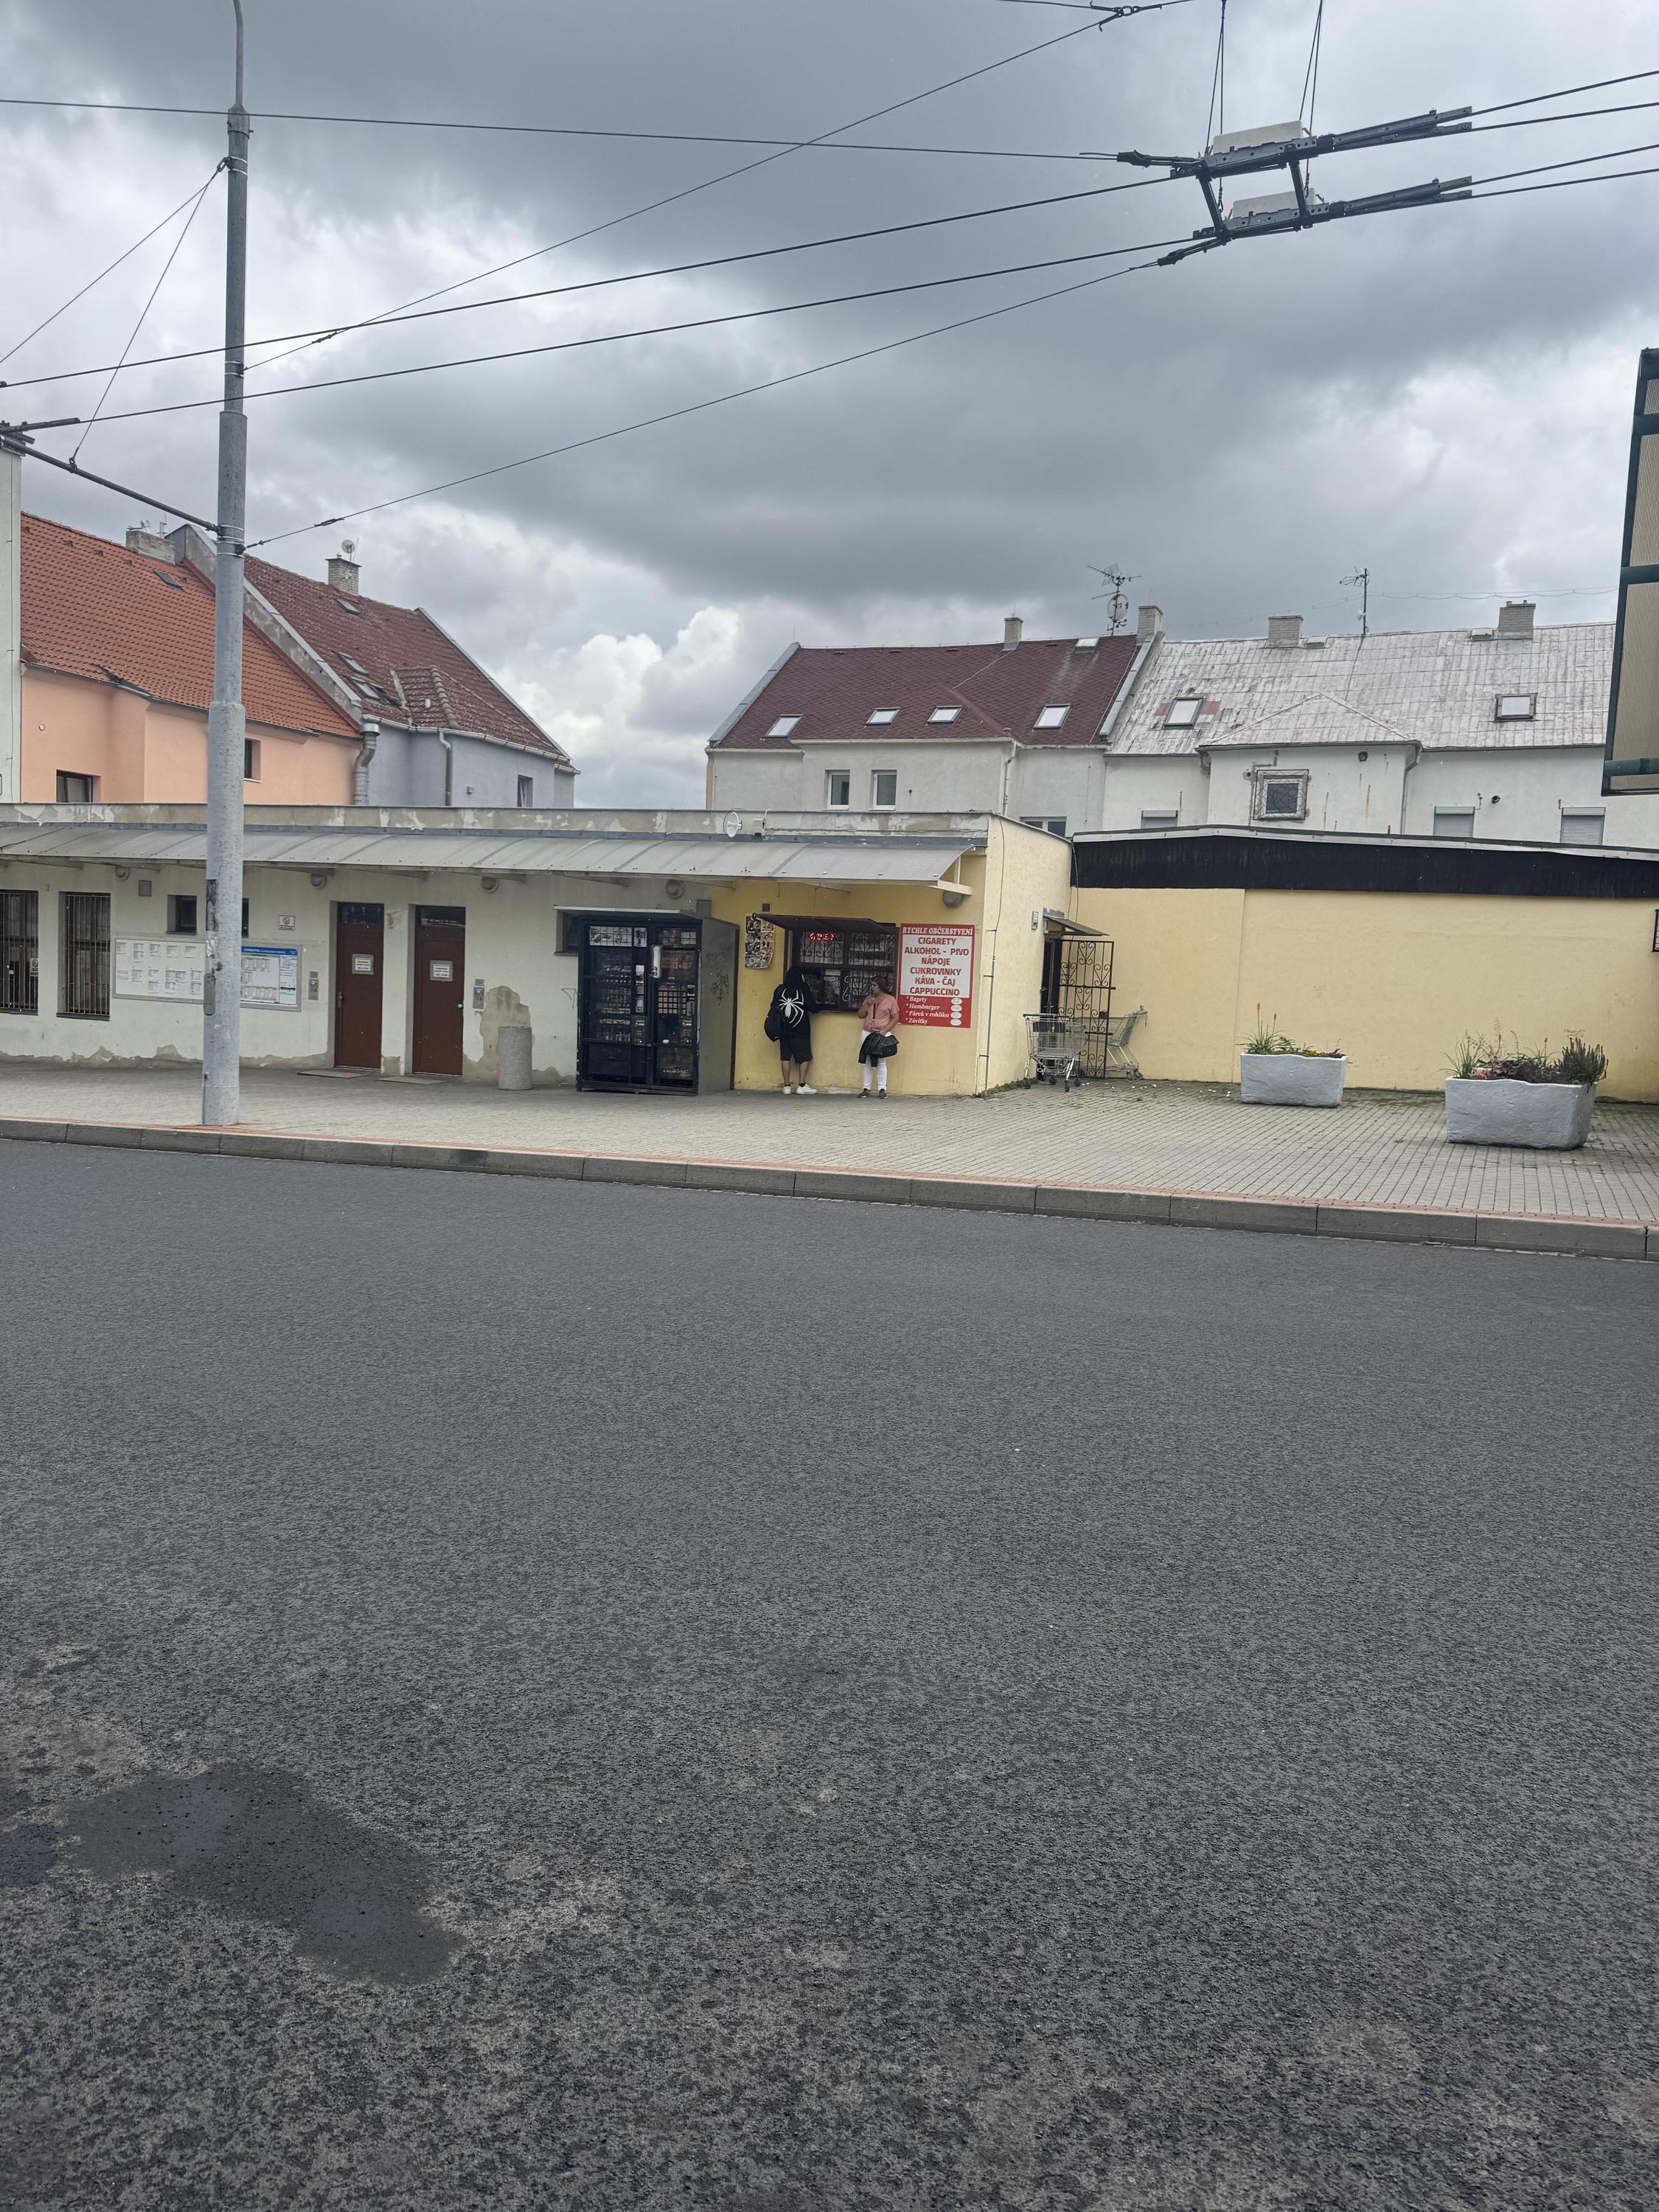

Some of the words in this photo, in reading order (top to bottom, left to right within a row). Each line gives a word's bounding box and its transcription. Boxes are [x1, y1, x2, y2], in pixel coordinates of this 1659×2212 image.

[928, 926, 973, 935] OBČERSTVENÍ
[905, 947, 942, 955] ALKOHOL
[921, 955, 950, 966] NÁPOJE
[910, 967, 961, 975] CUKROVINKY
[915, 975, 935, 985] KÁVA
[942, 976, 956, 987] ČAJ
[910, 987, 960, 996] CAPPUCCINO
